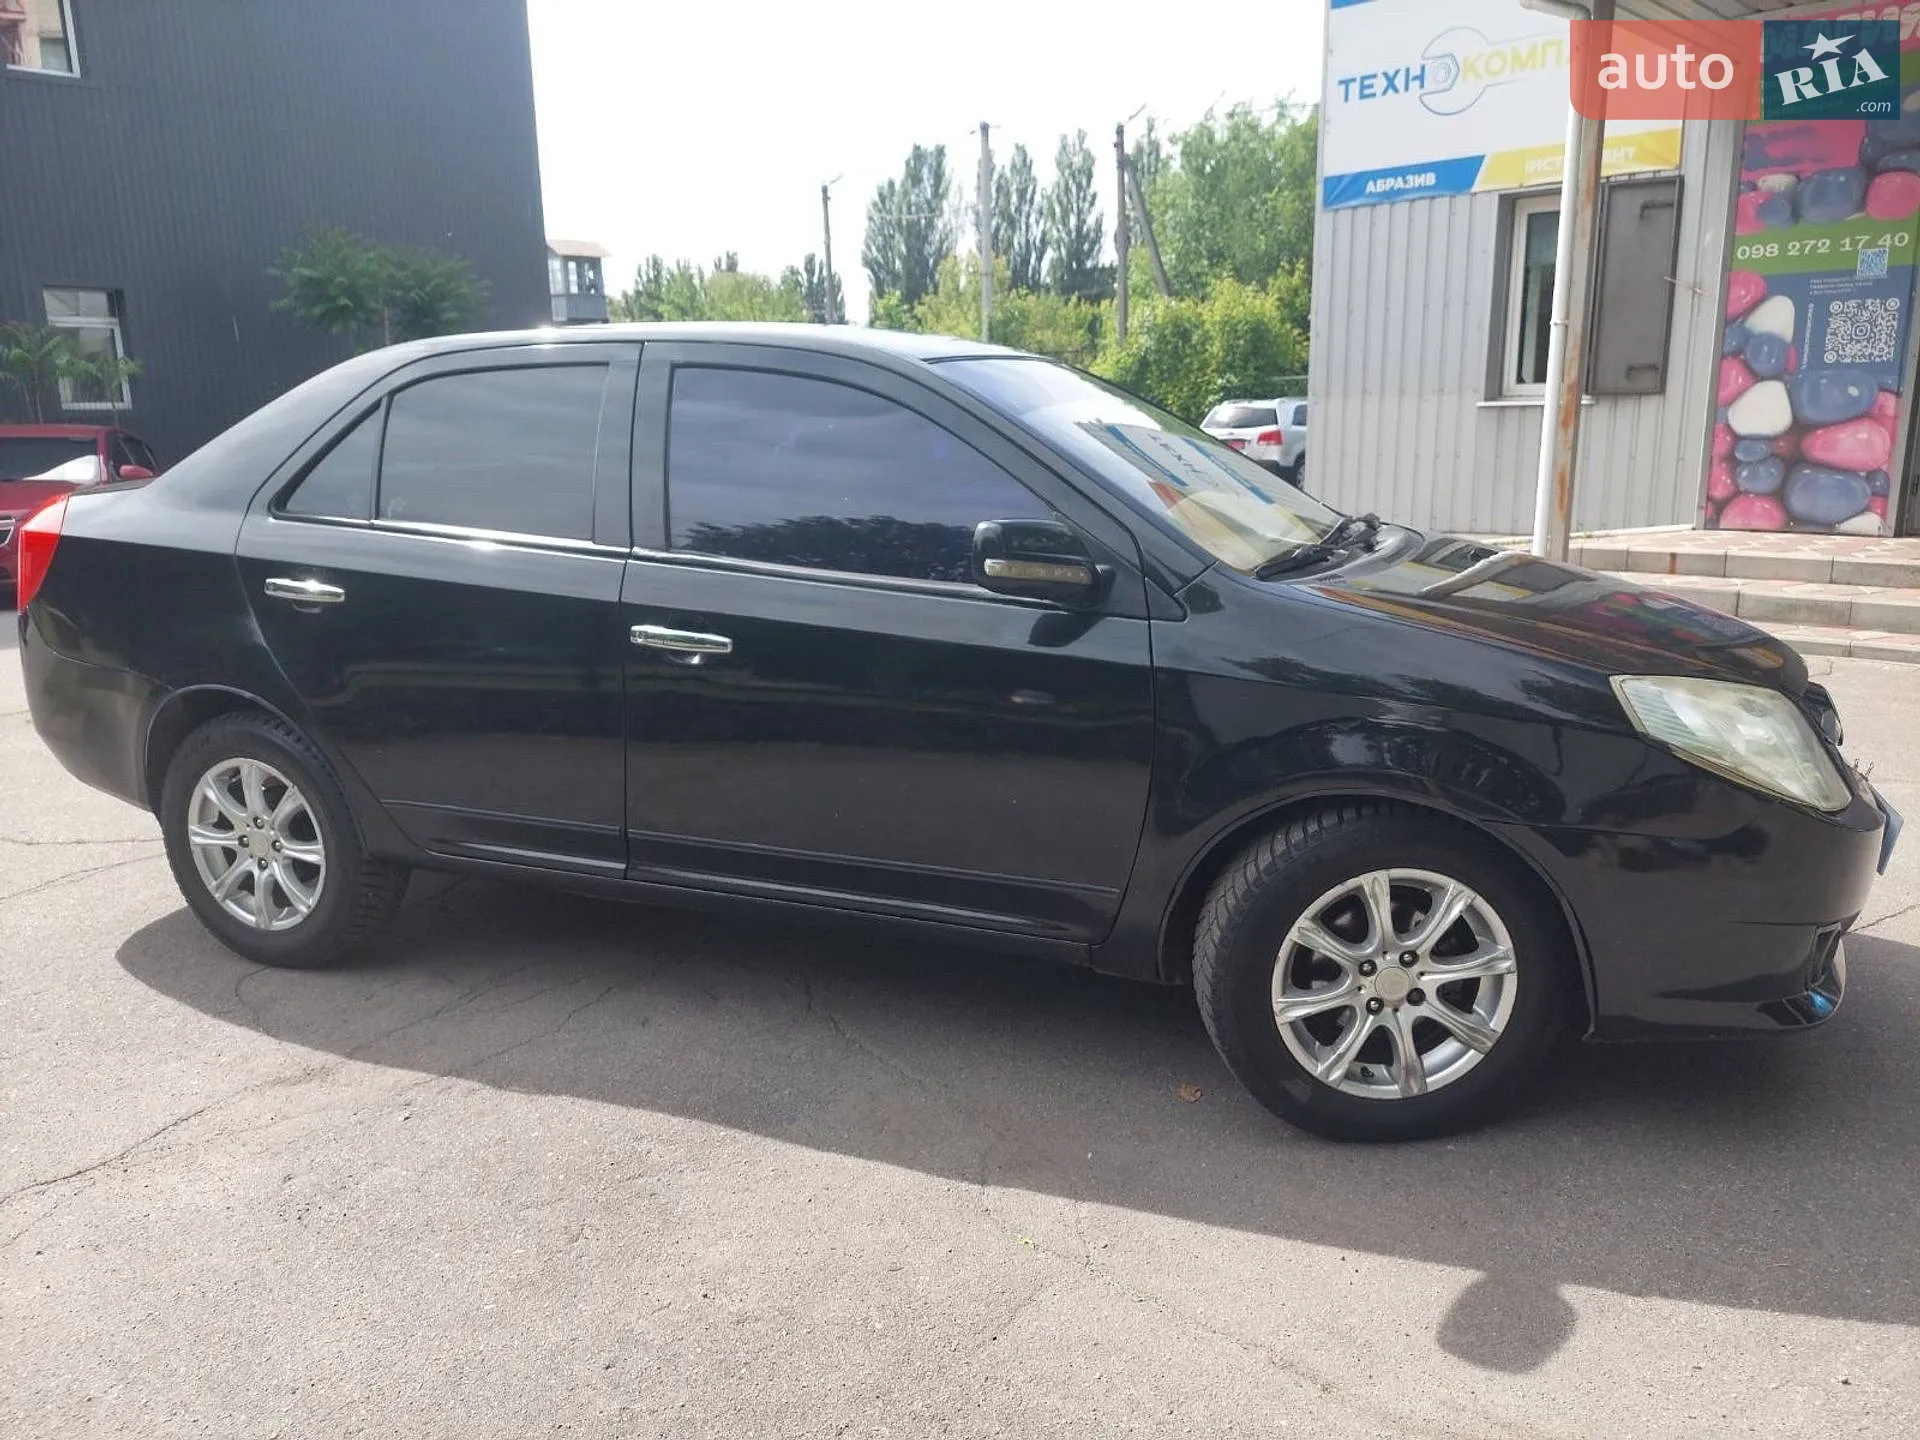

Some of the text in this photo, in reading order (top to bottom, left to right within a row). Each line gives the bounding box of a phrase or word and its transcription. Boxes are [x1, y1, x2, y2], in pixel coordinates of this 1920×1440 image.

[1365, 172, 1437, 194] АБРАЗИВ
[1736, 232, 1909, 260] 098 272 17 40
